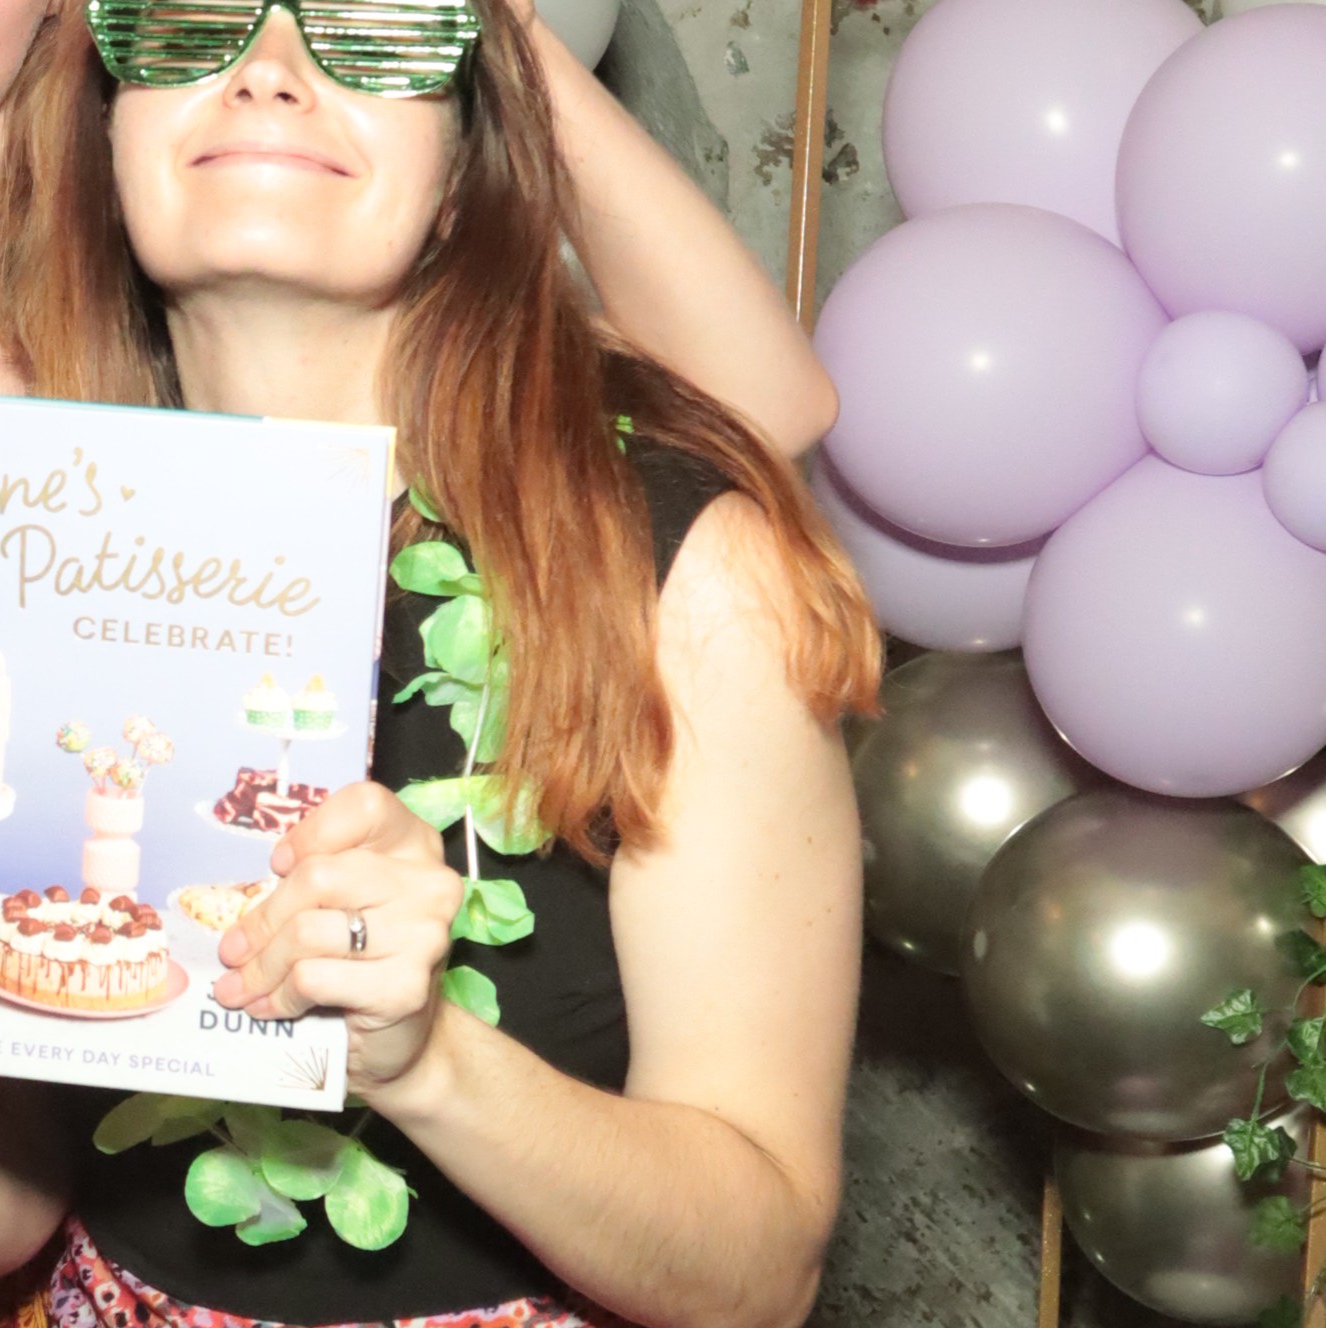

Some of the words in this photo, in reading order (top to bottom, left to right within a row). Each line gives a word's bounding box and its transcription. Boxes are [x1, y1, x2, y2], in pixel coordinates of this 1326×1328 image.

[0, 524, 321, 617] Patisserie
[72, 616, 294, 658] CELEBRATE!
[199, 1009, 295, 1038] DUNN
[10, 1041, 75, 1062] EVERY
[82, 1049, 121, 1067] DAY
[128, 1054, 216, 1078] SPECIAL
